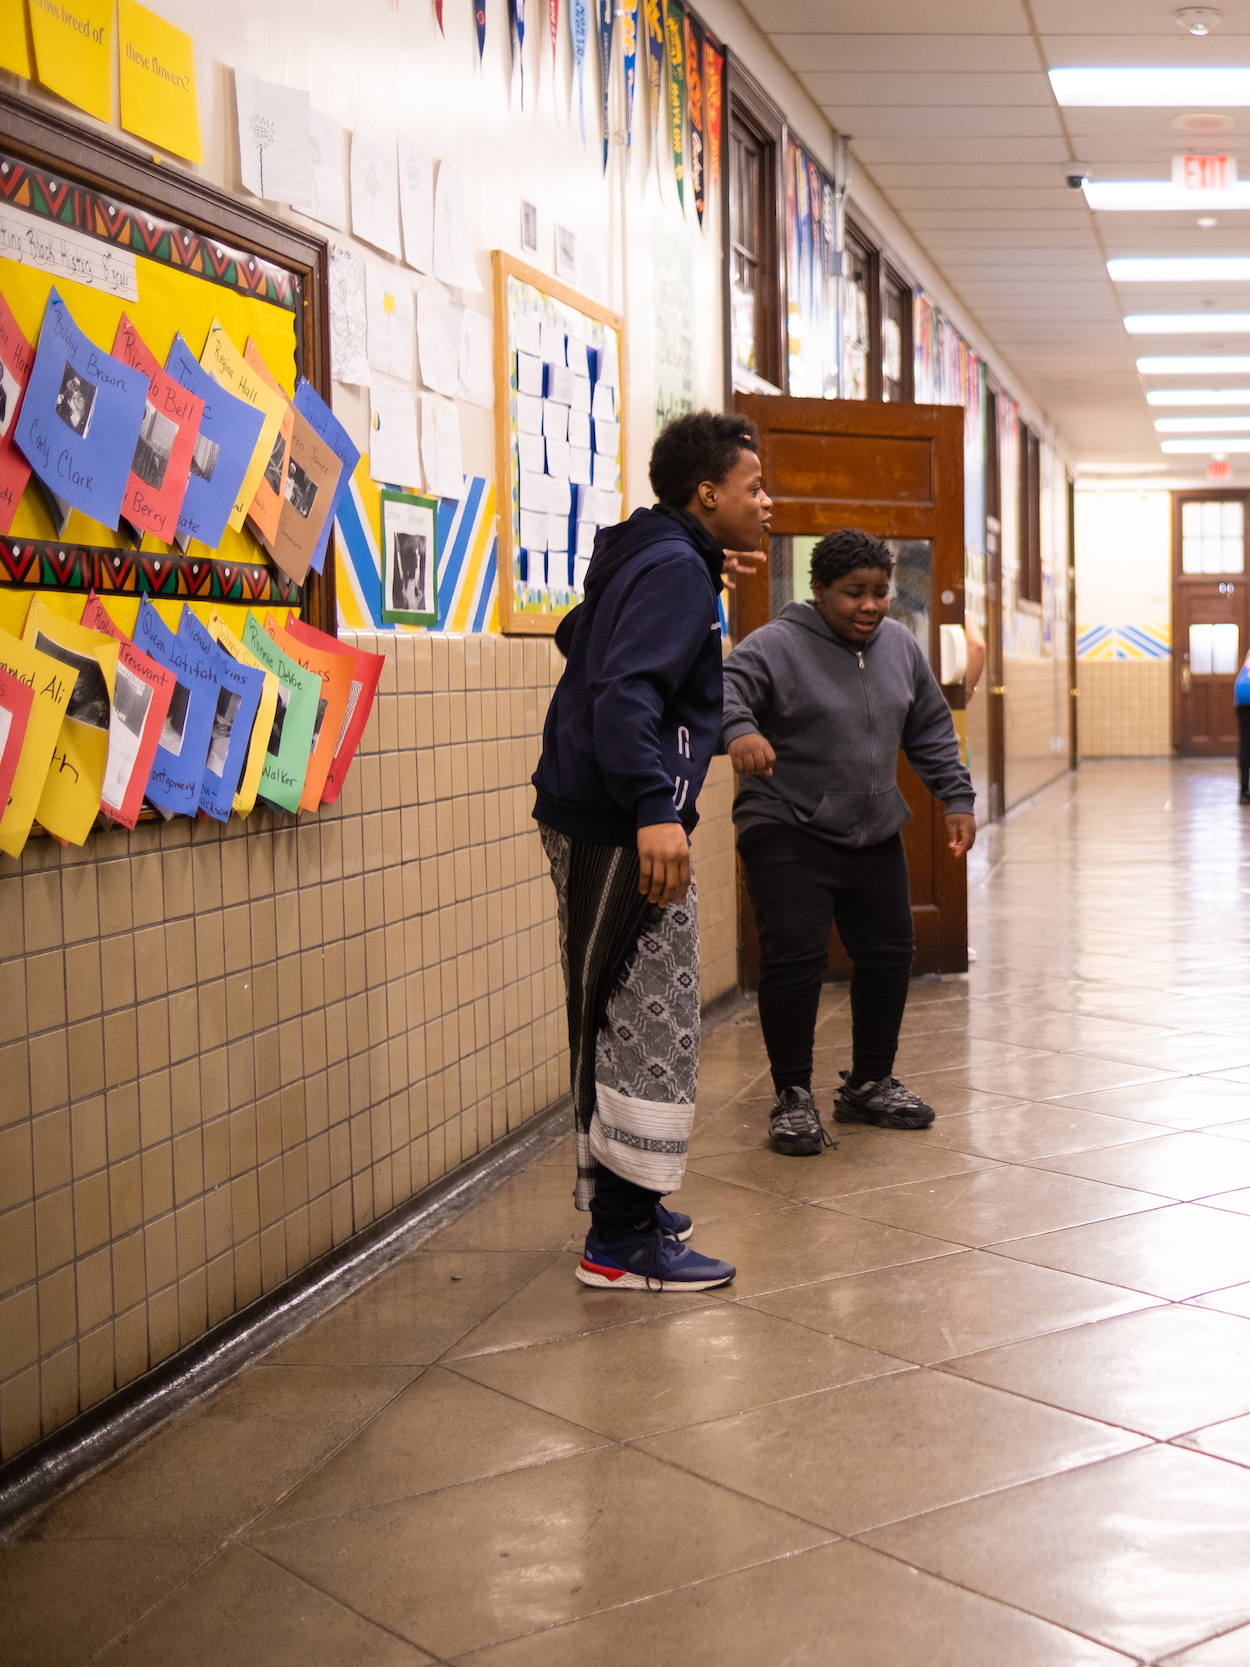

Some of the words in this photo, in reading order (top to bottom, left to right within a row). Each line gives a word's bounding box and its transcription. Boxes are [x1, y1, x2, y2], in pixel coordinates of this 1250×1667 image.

[61, 3, 91, 38] breed
[92, 27, 105, 45] of
[125, 42, 150, 70] these
[151, 56, 191, 92] flowers?
[1183, 155, 1229, 190] EXIT
[26, 229, 56, 262] Black
[60, 240, 94, 284] History
[53, 309, 78, 359] Bobby
[86, 353, 127, 392] Brown
[214, 339, 234, 380] Regina
[238, 374, 258, 403] Hall
[164, 387, 194, 421] Bell
[29, 418, 50, 468] Carly
[57, 449, 94, 492] Clark
[309, 445, 328, 474] James
[132, 491, 167, 532] Berry
[142, 611, 165, 653] Queen
[169, 640, 218, 684] Latifah
[184, 617, 211, 655] Michael
[249, 625, 274, 669] Ronnie
[119, 641, 169, 687] Tressvant
[40, 675, 66, 704] Ali
[151, 767, 196, 800] ontgomery
[261, 765, 298, 787] Walker
[200, 797, 229, 818] ackson
